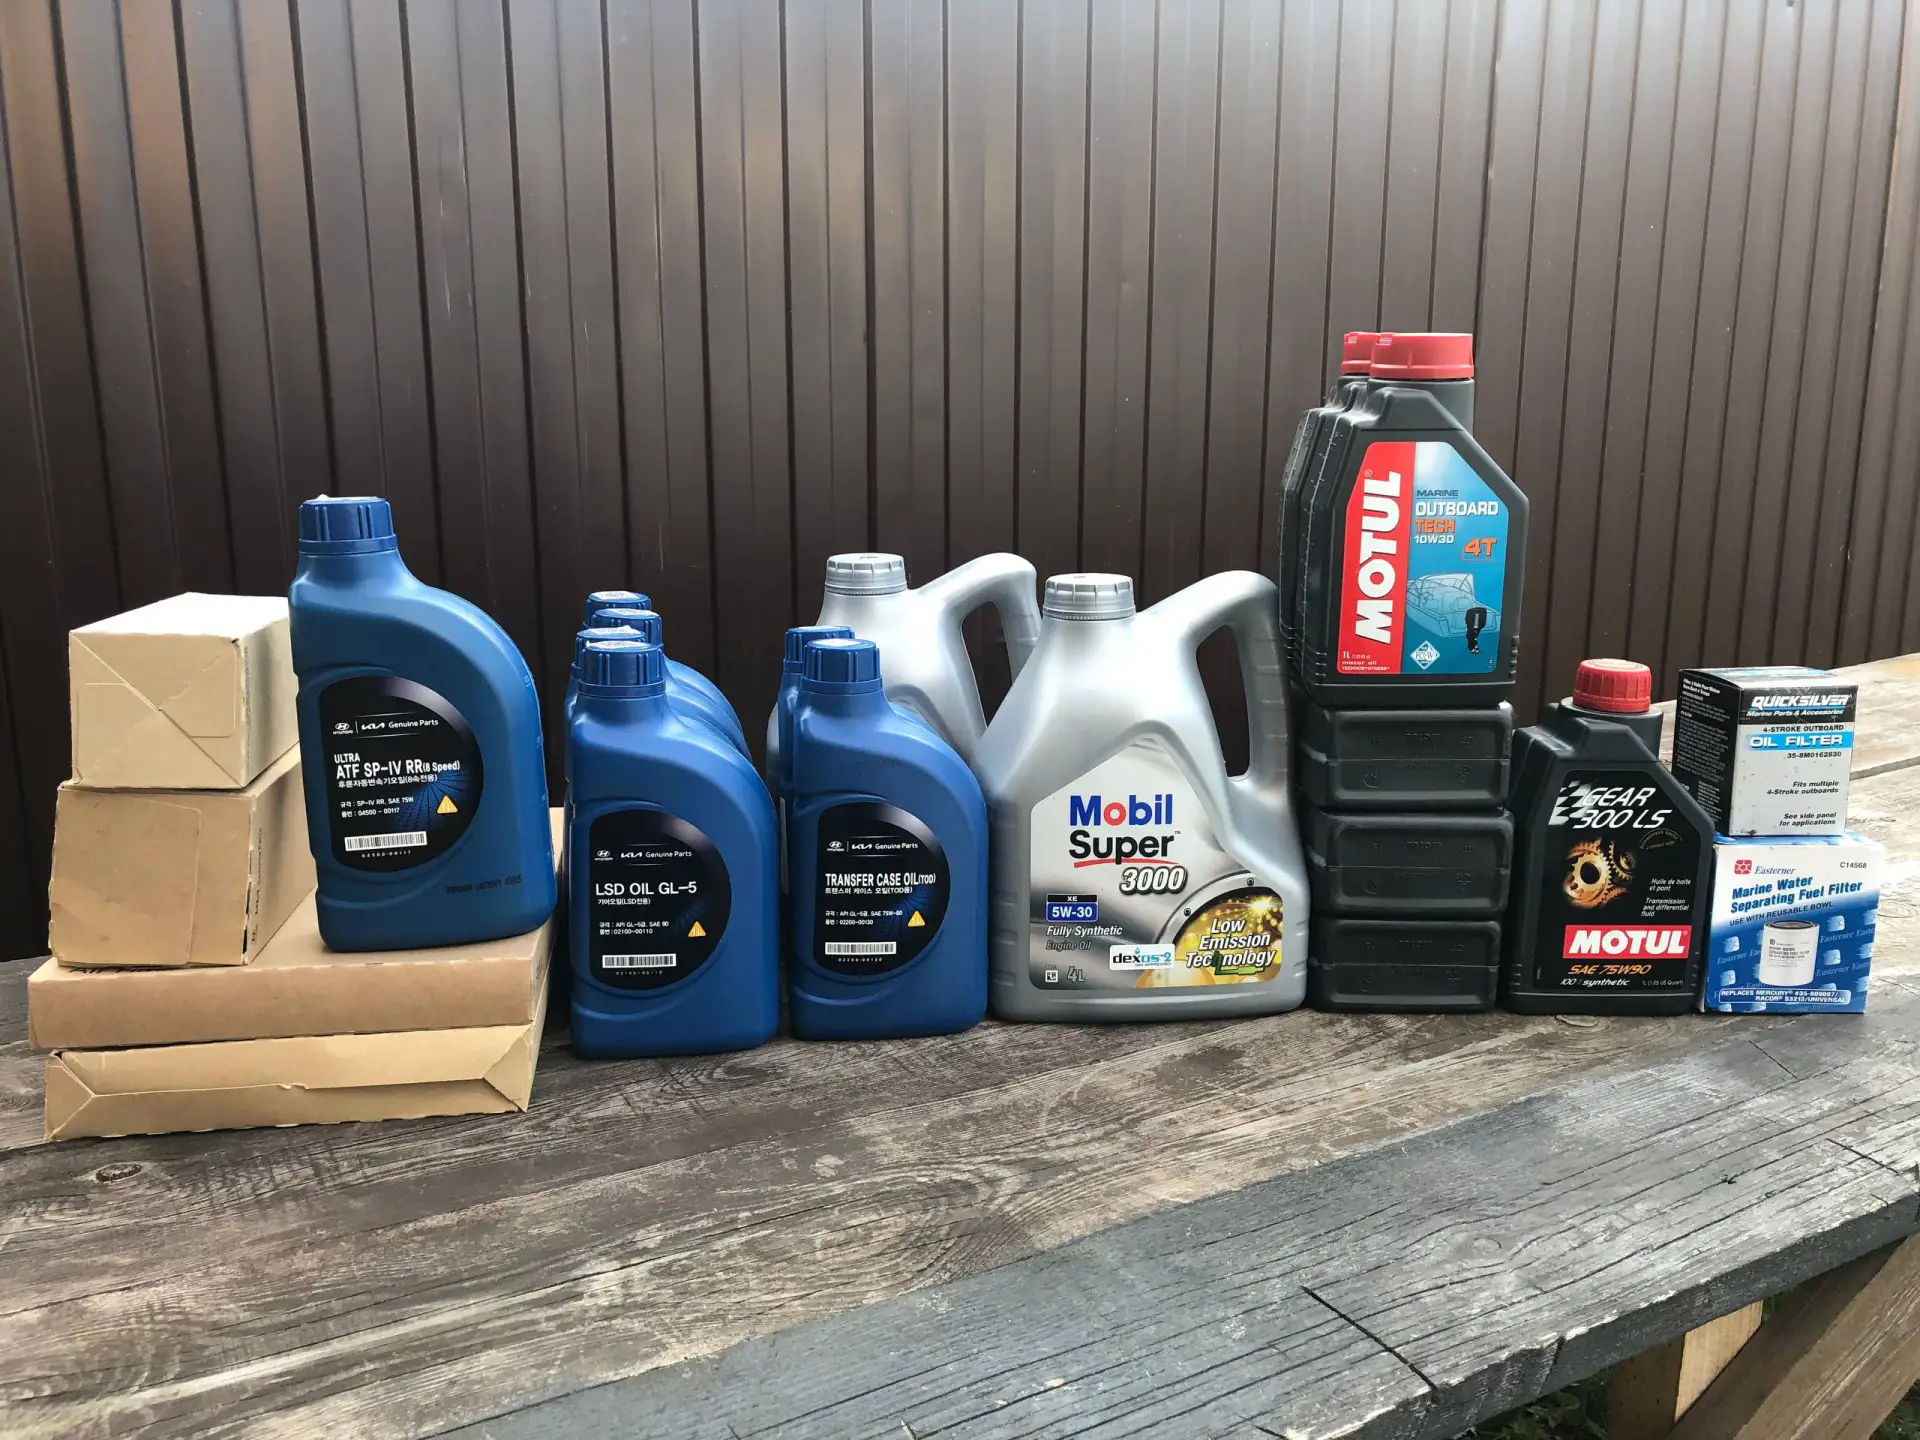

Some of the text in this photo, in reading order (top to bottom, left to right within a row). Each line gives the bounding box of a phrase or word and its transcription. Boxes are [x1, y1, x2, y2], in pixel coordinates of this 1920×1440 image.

[1416, 489, 1459, 497] MARINE
[1415, 501, 1499, 516] OUTBOARD
[1415, 519, 1456, 534] TECH
[1414, 535, 1455, 545] 10W30
[1463, 537, 1498, 557] 4T
[1355, 470, 1401, 644] MOTUL
[1342, 651, 1351, 659] 1L
[1751, 694, 1849, 710] QUICKSILVER
[388, 720, 419, 728] Genuine
[1750, 734, 1843, 747] OIL FILTER
[334, 752, 360, 763] ULTRA
[336, 763, 360, 779] ATF
[364, 760, 401, 777] SP-IV
[357, 799, 375, 807] SP-IV
[1583, 787, 1657, 808] GEAR
[1069, 794, 1173, 826] Mobil
[1573, 809, 1673, 829] 300 LS
[1791, 819, 1836, 827] applications
[1068, 830, 1175, 865] Super
[1754, 865, 1796, 875] Easterner
[1840, 861, 1867, 869] C14568
[825, 873, 874, 887] TRANSFER
[876, 872, 901, 886] CASE
[1119, 866, 1188, 895] 3000
[595, 881, 697, 896] LSD OIL GL-5
[1732, 875, 1813, 900] Marine Water
[1730, 881, 1863, 914] Separating Fuel Filter
[1051, 906, 1093, 918] 5W-30
[1729, 901, 1834, 927] USE WITH REUSABLE BOWL
[1046, 925, 1123, 937] Fully Synthetic
[1211, 918, 1247, 934] Low
[1199, 932, 1271, 951] Emission
[1569, 930, 1685, 955] MOTUL
[1820, 932, 1854, 944] Easterner
[1046, 940, 1092, 952] Engine Oil
[1067, 966, 1086, 983] 4L
[1568, 964, 1652, 975] SAE 75W90
[1816, 965, 1850, 977] Easterner
[1582, 978, 1630, 986] synthetic
